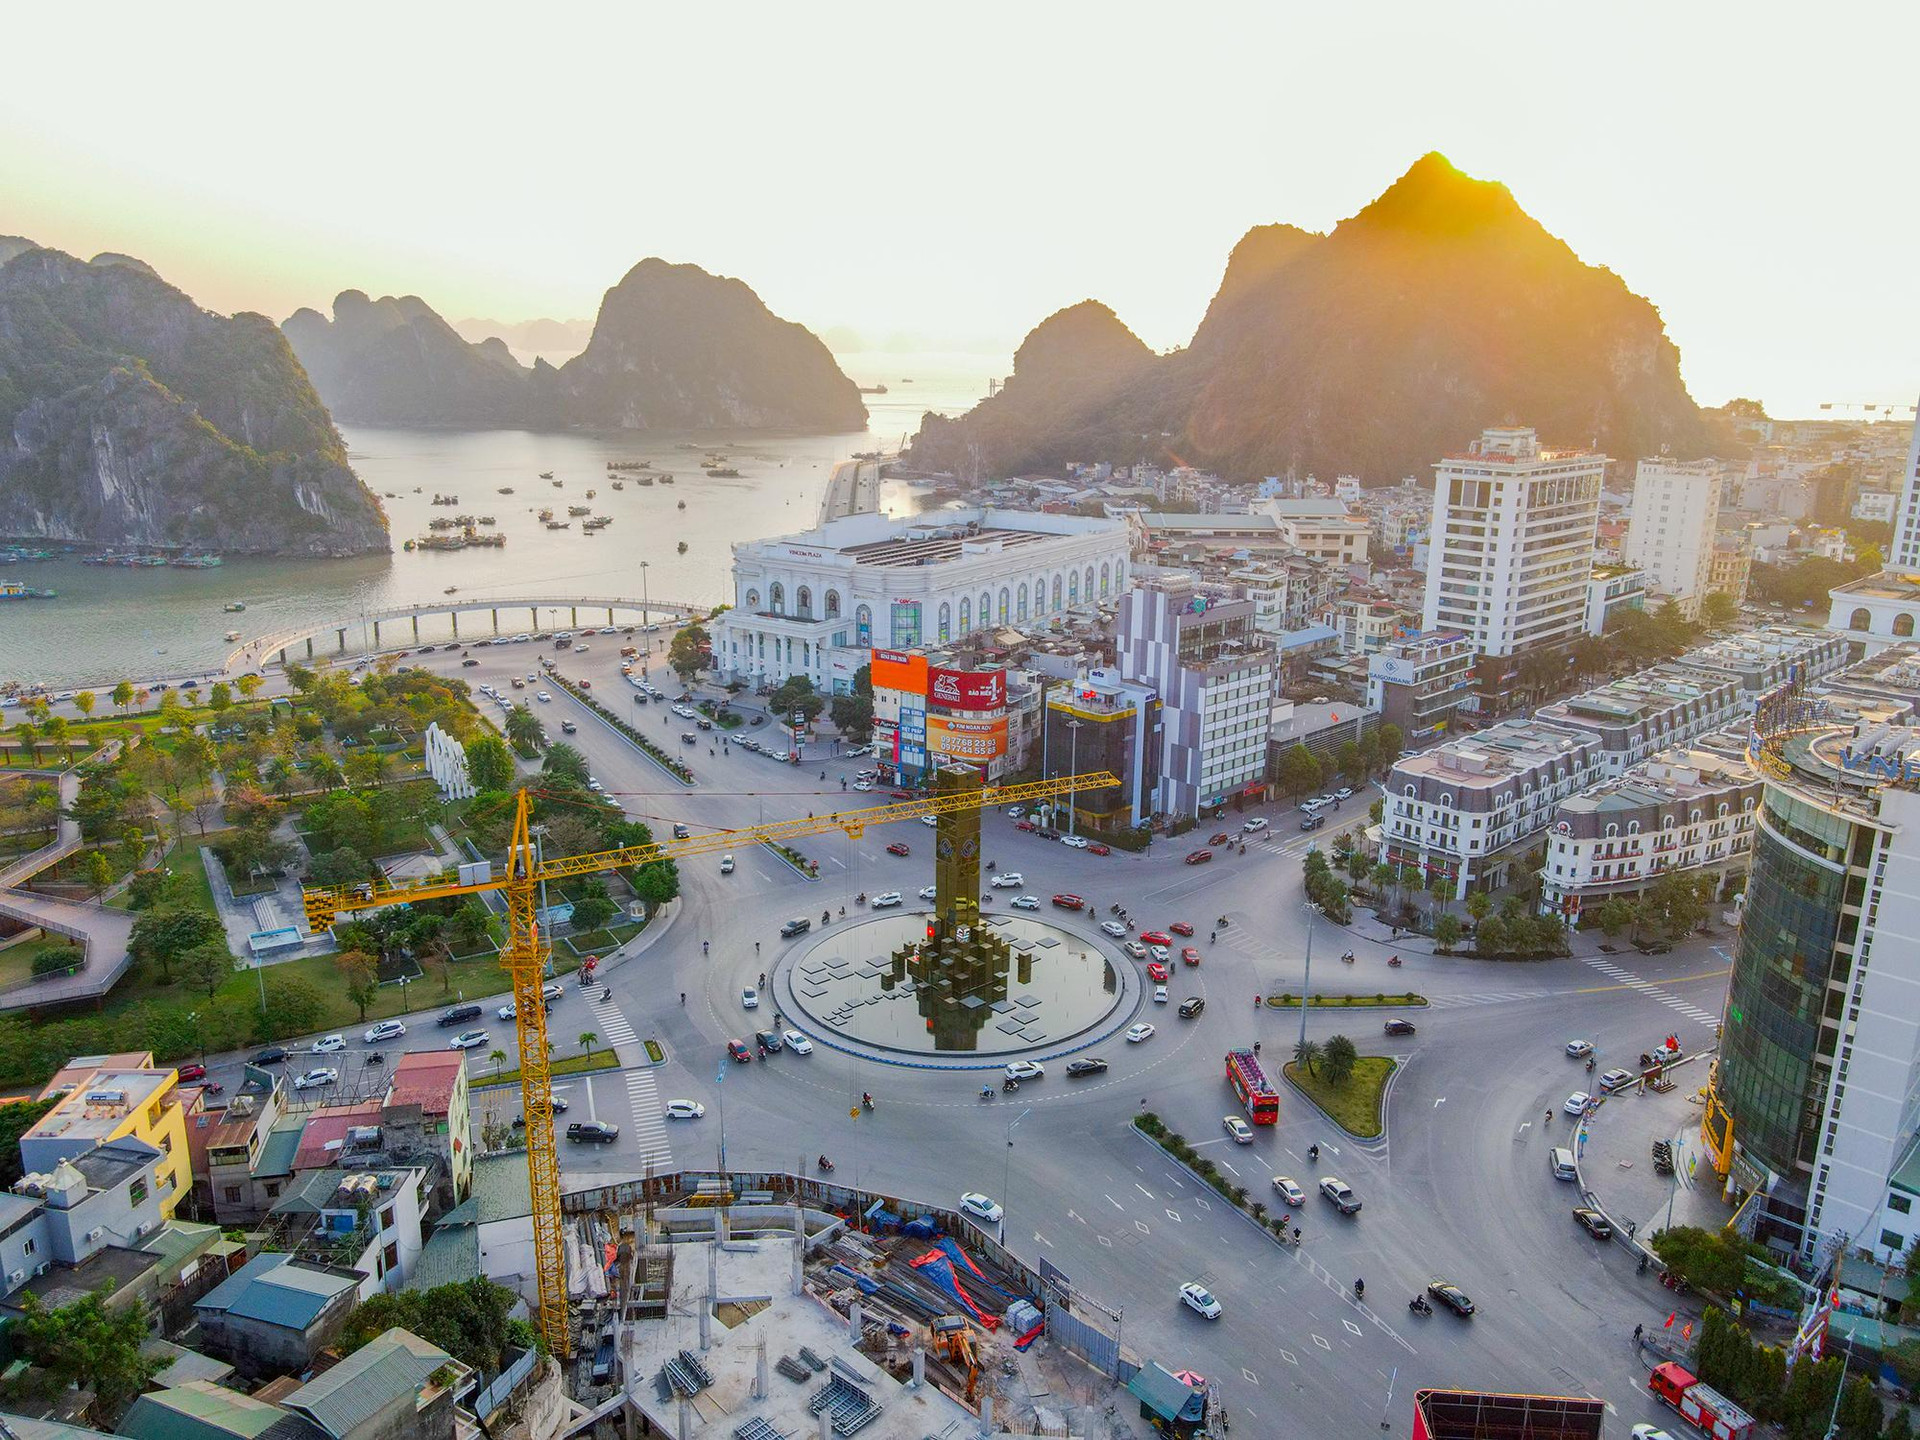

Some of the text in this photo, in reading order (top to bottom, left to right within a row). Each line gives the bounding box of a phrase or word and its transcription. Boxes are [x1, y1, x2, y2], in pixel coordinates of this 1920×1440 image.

[807, 551, 823, 559] PLAZA
[1368, 672, 1412, 685] SAIGONBANK
[933, 691, 961, 703] GENERALI
